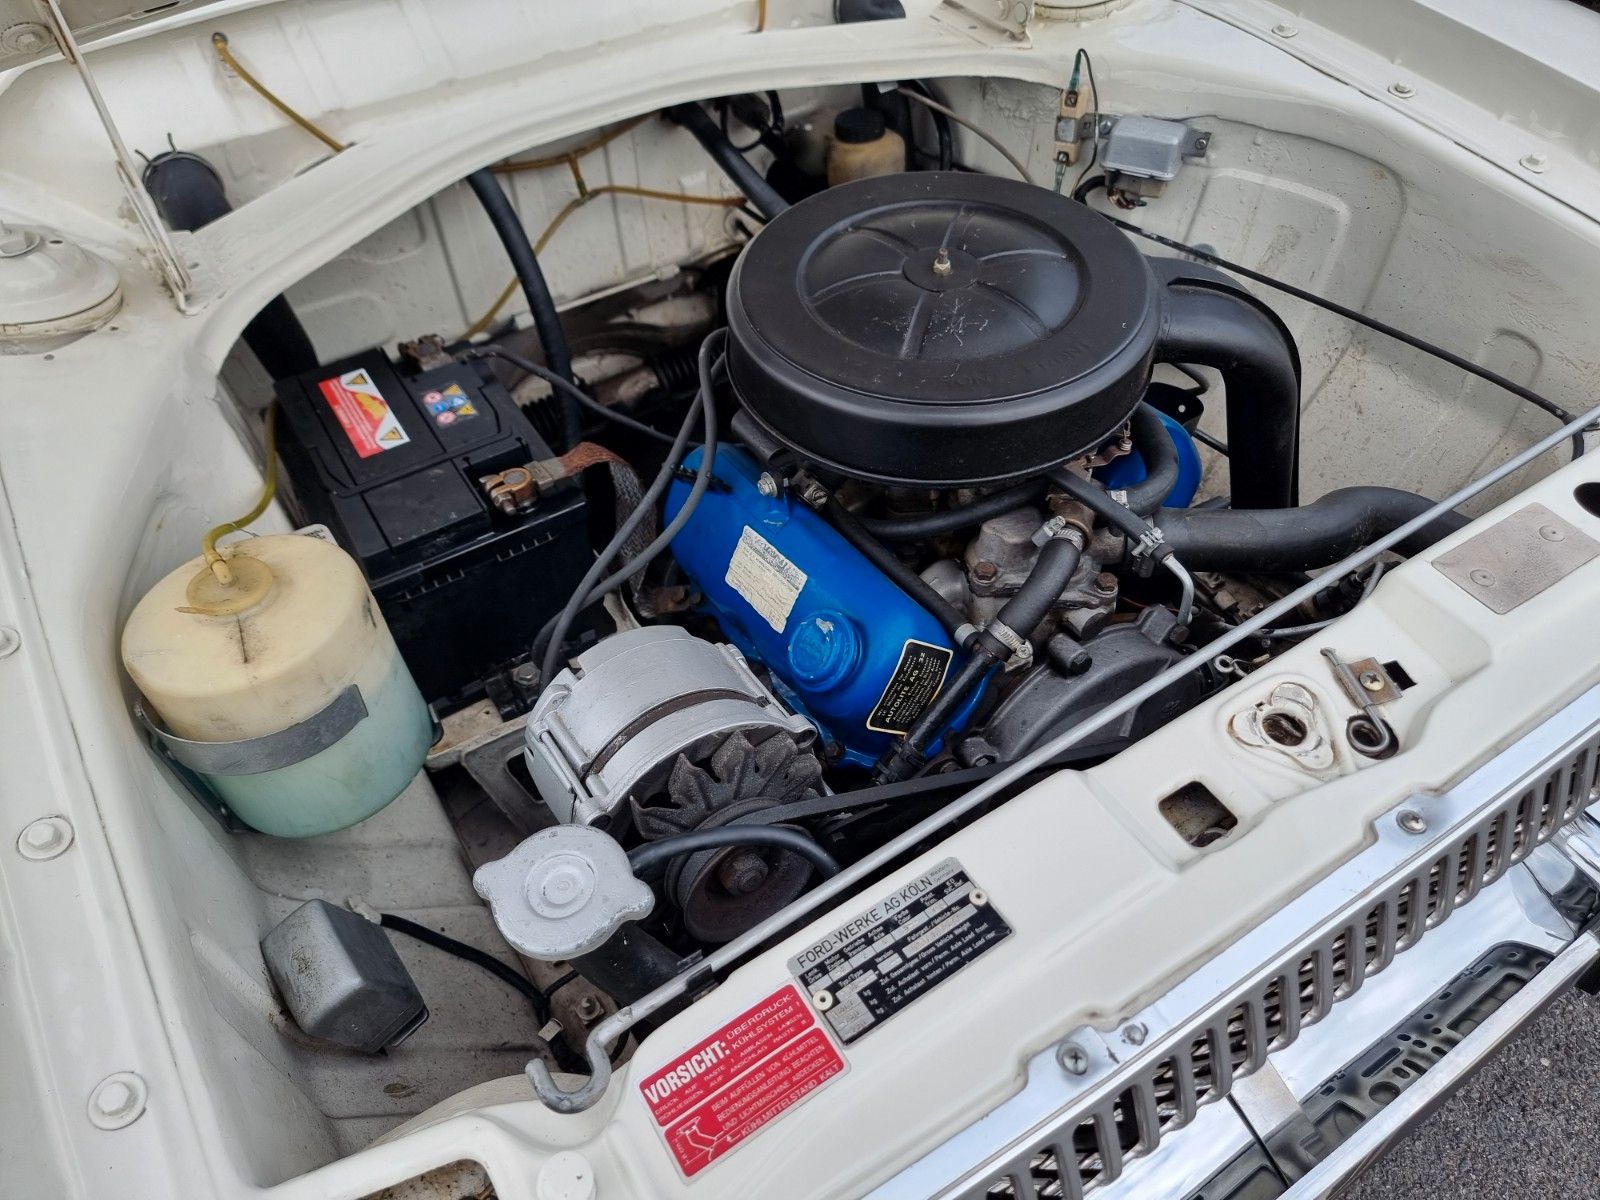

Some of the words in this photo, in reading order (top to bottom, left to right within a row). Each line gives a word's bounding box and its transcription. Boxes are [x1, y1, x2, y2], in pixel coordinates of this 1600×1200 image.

[884, 684, 909, 723] AUTOLITE
[909, 669, 919, 682] AG
[796, 907, 882, 968] FORD-WERKE
[881, 895, 901, 913] AG
[897, 873, 933, 902] KÖLN
[725, 990, 795, 1040] ÜBERDRUCK-
[730, 1003, 794, 1050] KÜHLSYSTEM
[642, 1037, 731, 1107] VORSICHT:
[710, 1095, 729, 1112] BEIM
[727, 1069, 766, 1099] AUFFÜLLEN
[739, 1077, 818, 1137] KÜHLMITTELSTAND
[817, 1062, 840, 1082] KALT
